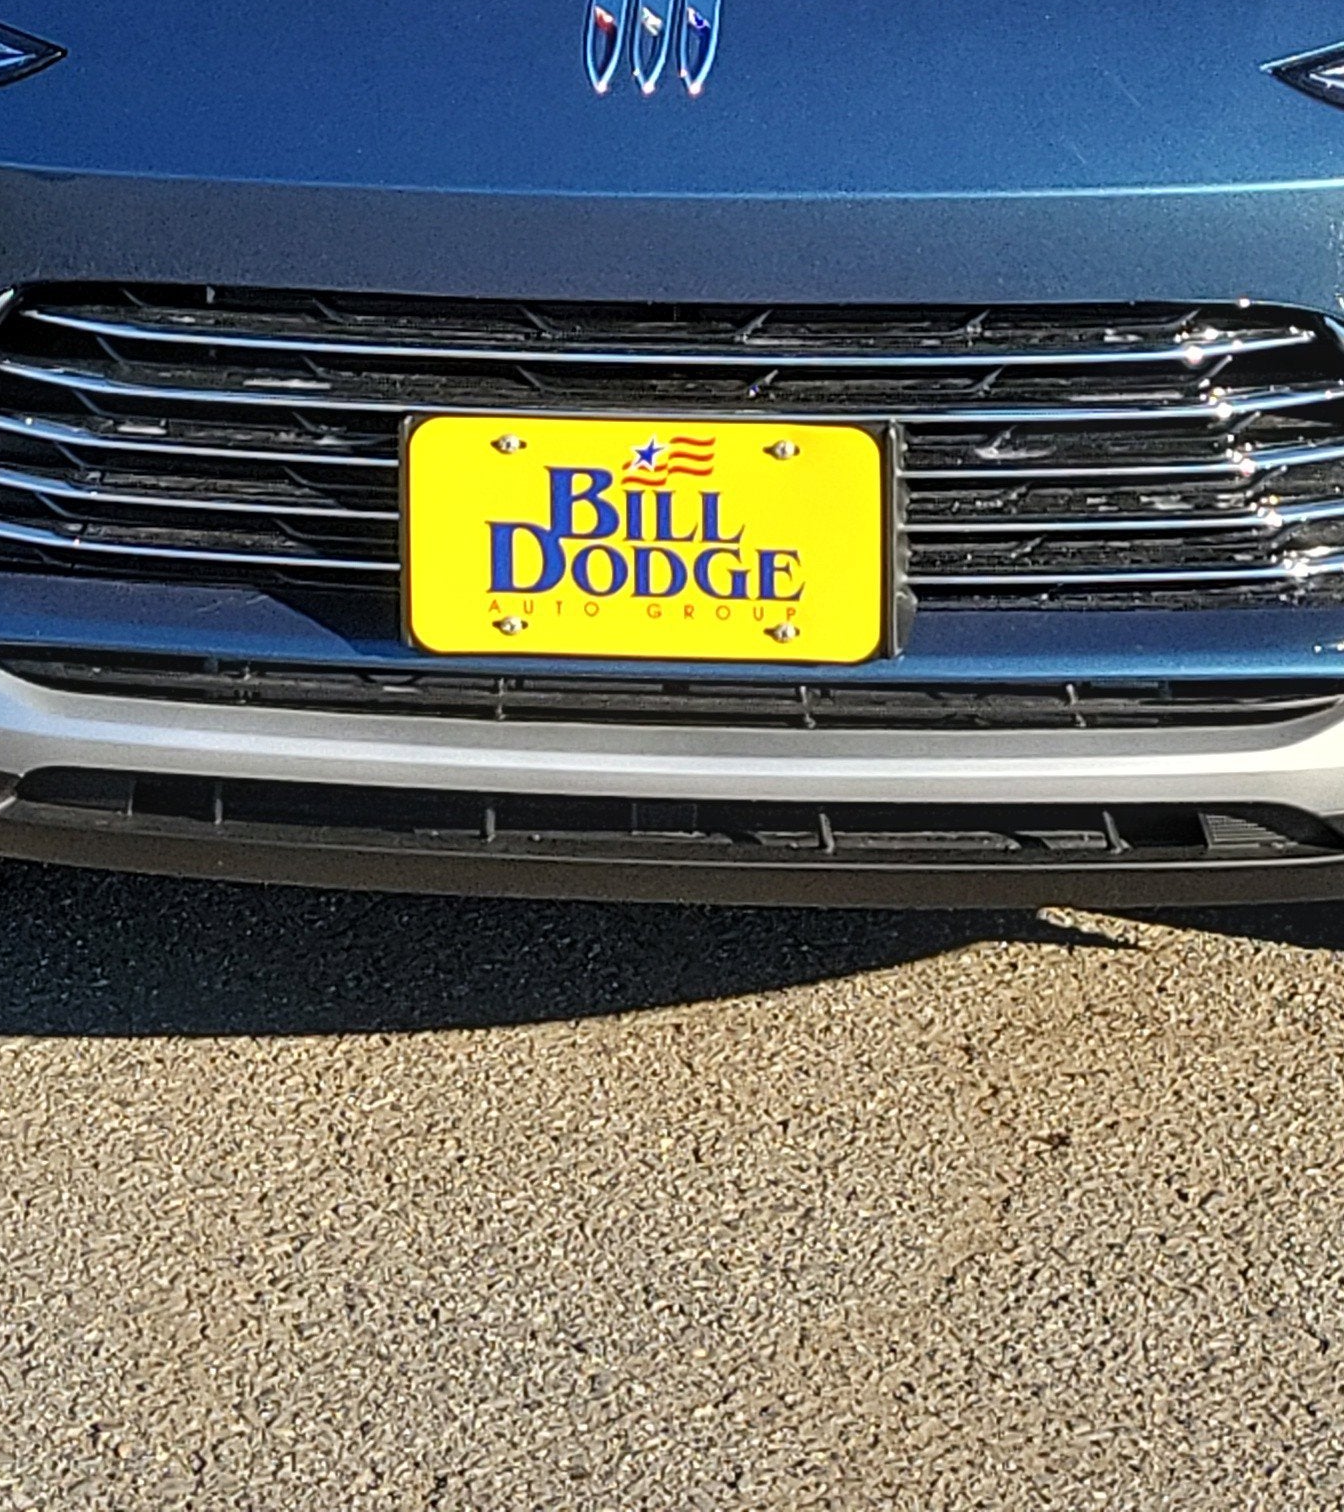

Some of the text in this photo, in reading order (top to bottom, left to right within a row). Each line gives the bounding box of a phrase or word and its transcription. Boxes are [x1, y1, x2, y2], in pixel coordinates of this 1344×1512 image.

[544, 465, 746, 544] BILL
[484, 519, 807, 603] DODGE
[488, 599, 798, 622] AUTO GROUP
